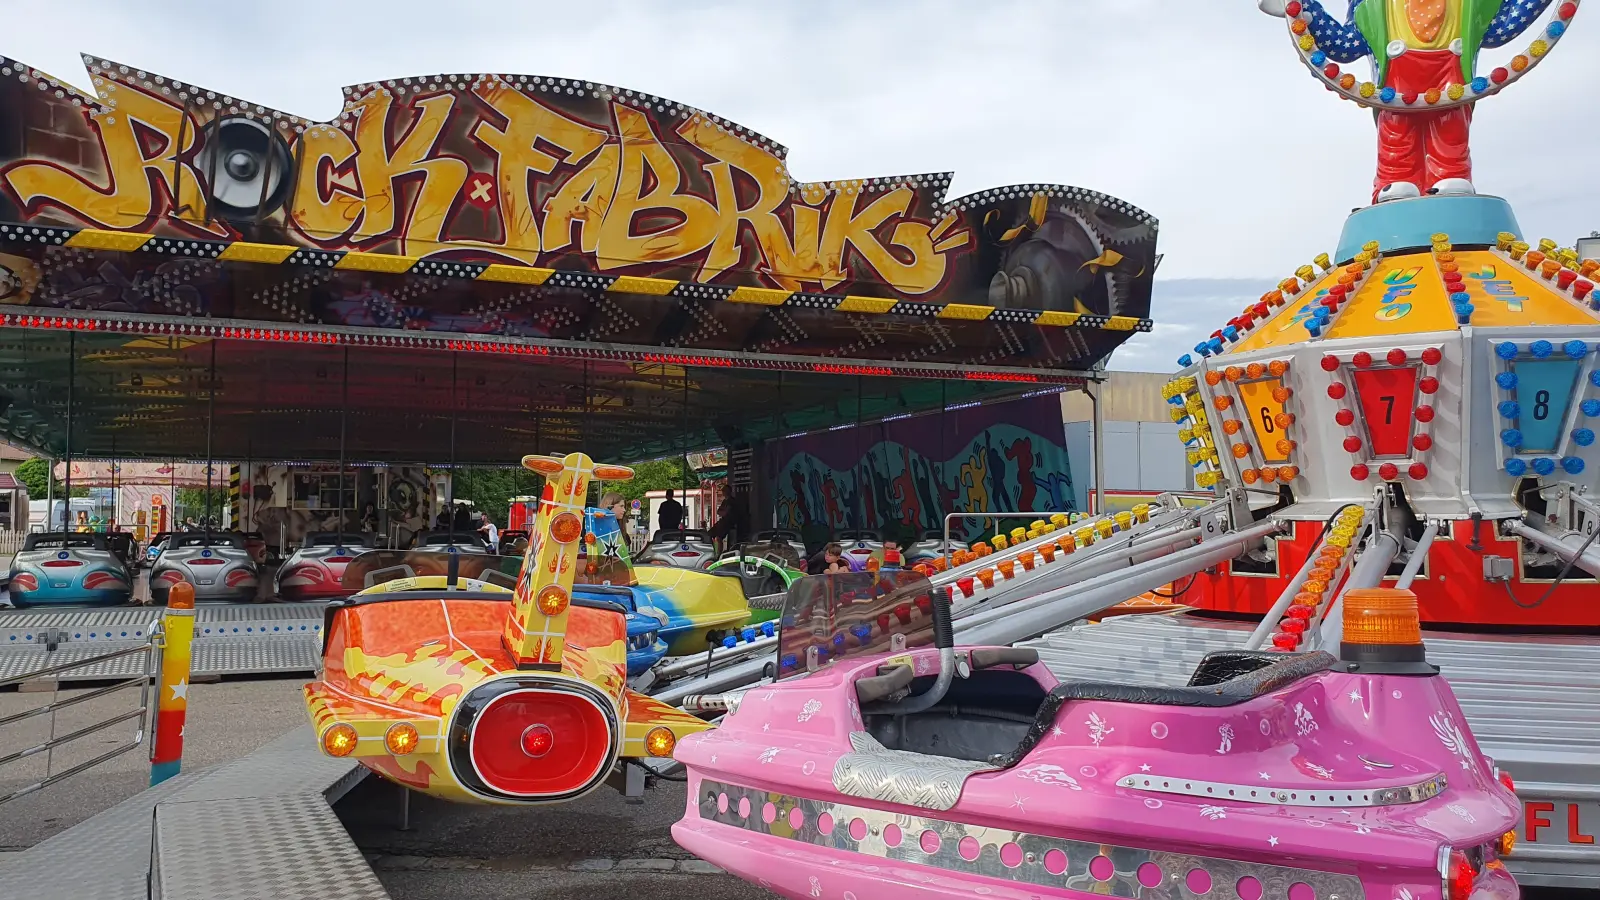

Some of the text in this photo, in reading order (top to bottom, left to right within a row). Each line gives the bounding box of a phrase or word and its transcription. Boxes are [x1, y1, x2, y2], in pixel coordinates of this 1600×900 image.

[1374, 266, 1423, 321] UFO
[1470, 264, 1529, 312] JET
[1260, 406, 1274, 433] 6
[1380, 396, 1395, 425] 7
[1533, 390, 1549, 421] 8
[1206, 521, 1214, 533] 6
[1586, 520, 1592, 535] 8
[1525, 801, 1600, 844] FL
